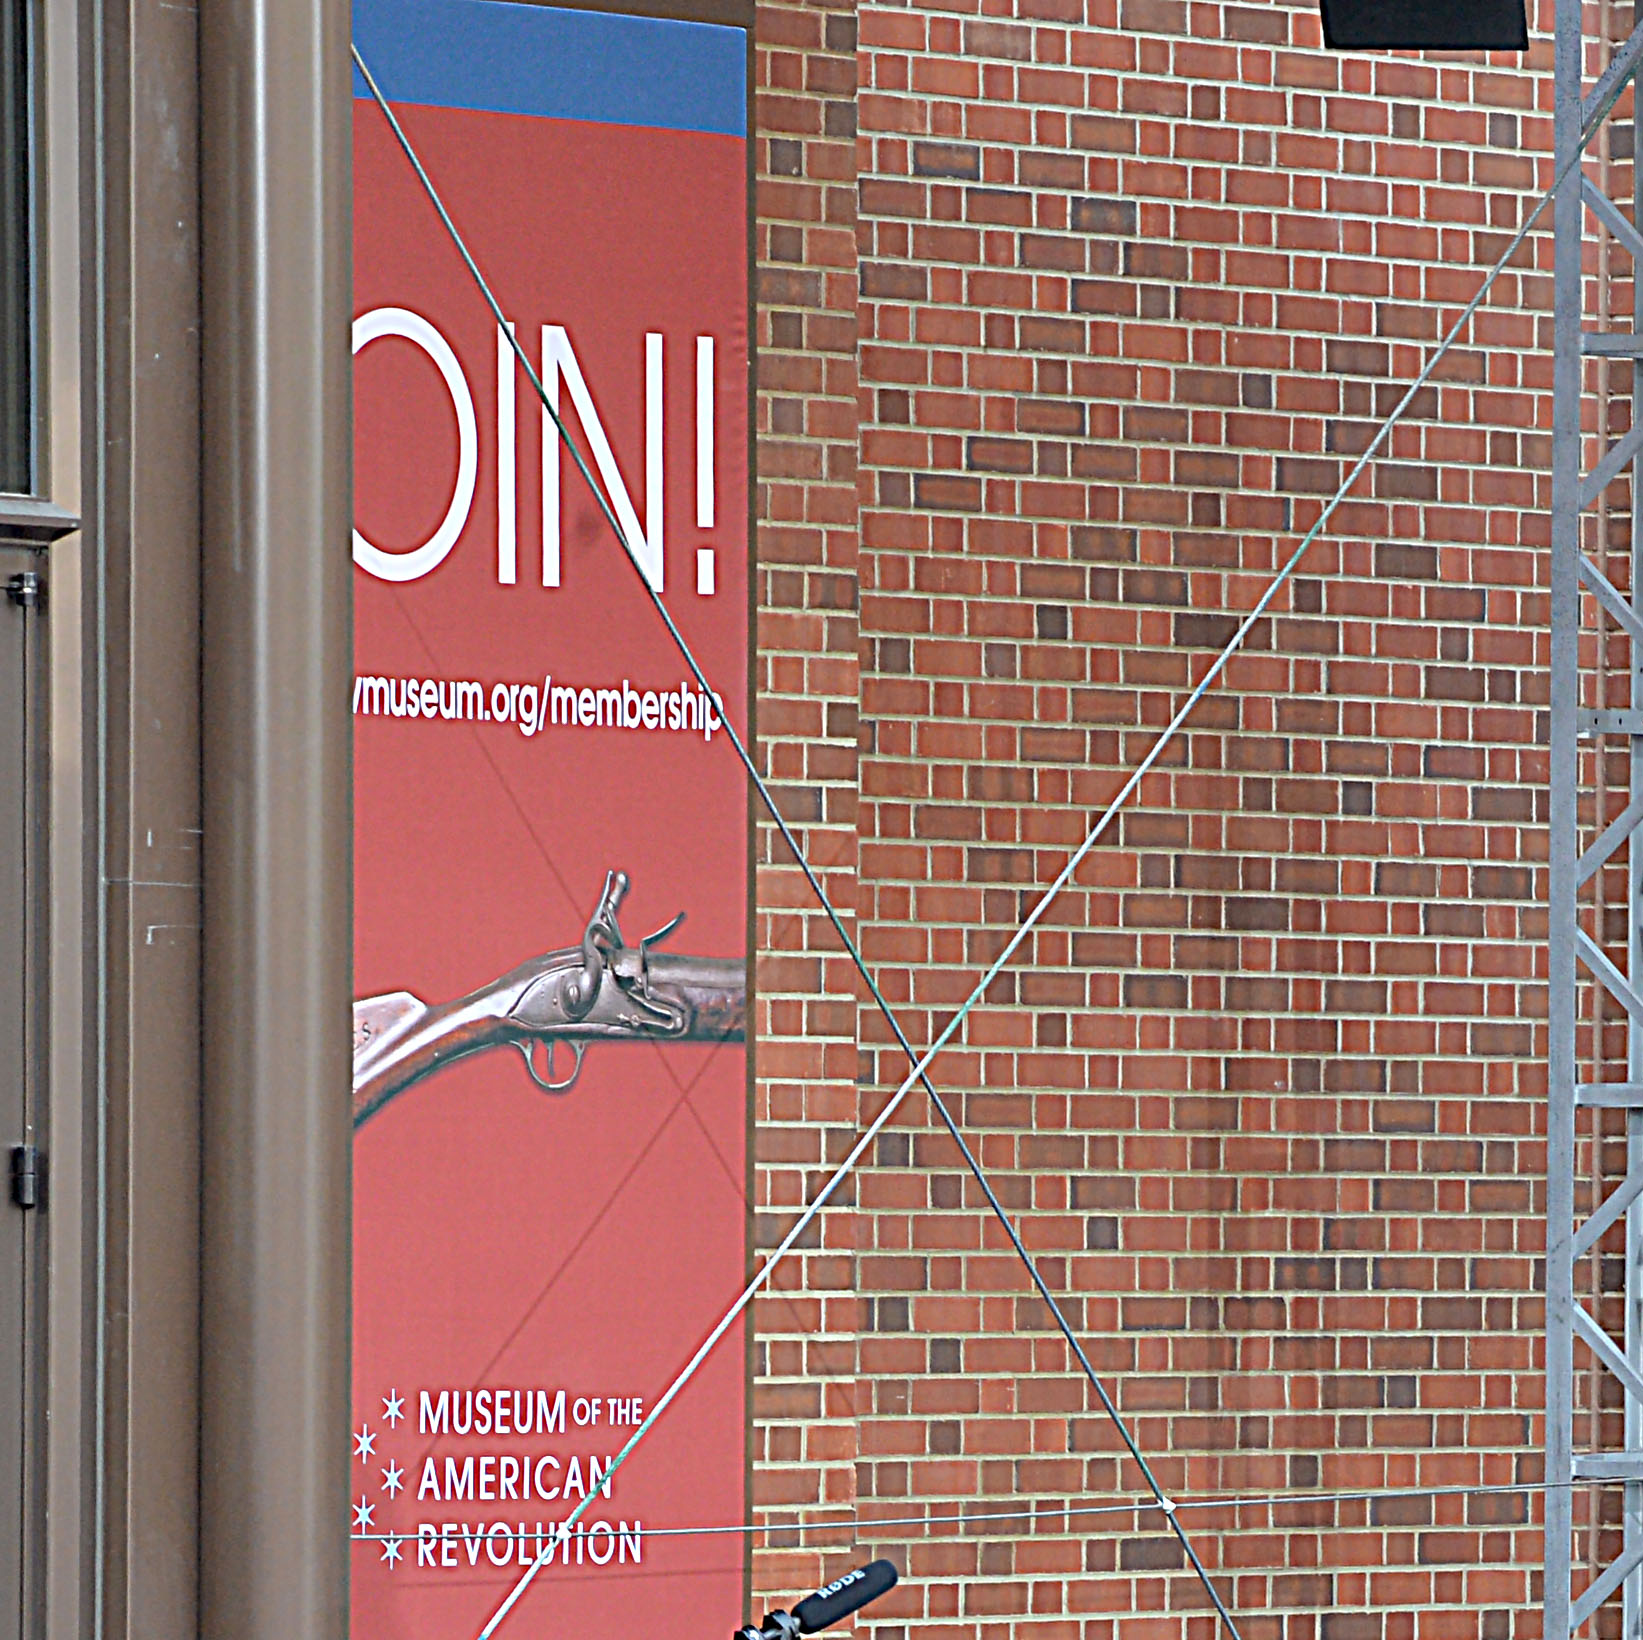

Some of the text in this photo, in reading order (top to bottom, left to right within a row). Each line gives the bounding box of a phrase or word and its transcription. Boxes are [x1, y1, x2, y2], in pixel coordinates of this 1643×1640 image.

[419, 1390, 643, 1434] MUSEUM OF THE
[416, 1455, 613, 1501] AMERICAN
[417, 1520, 642, 1567] REVOLUTION
